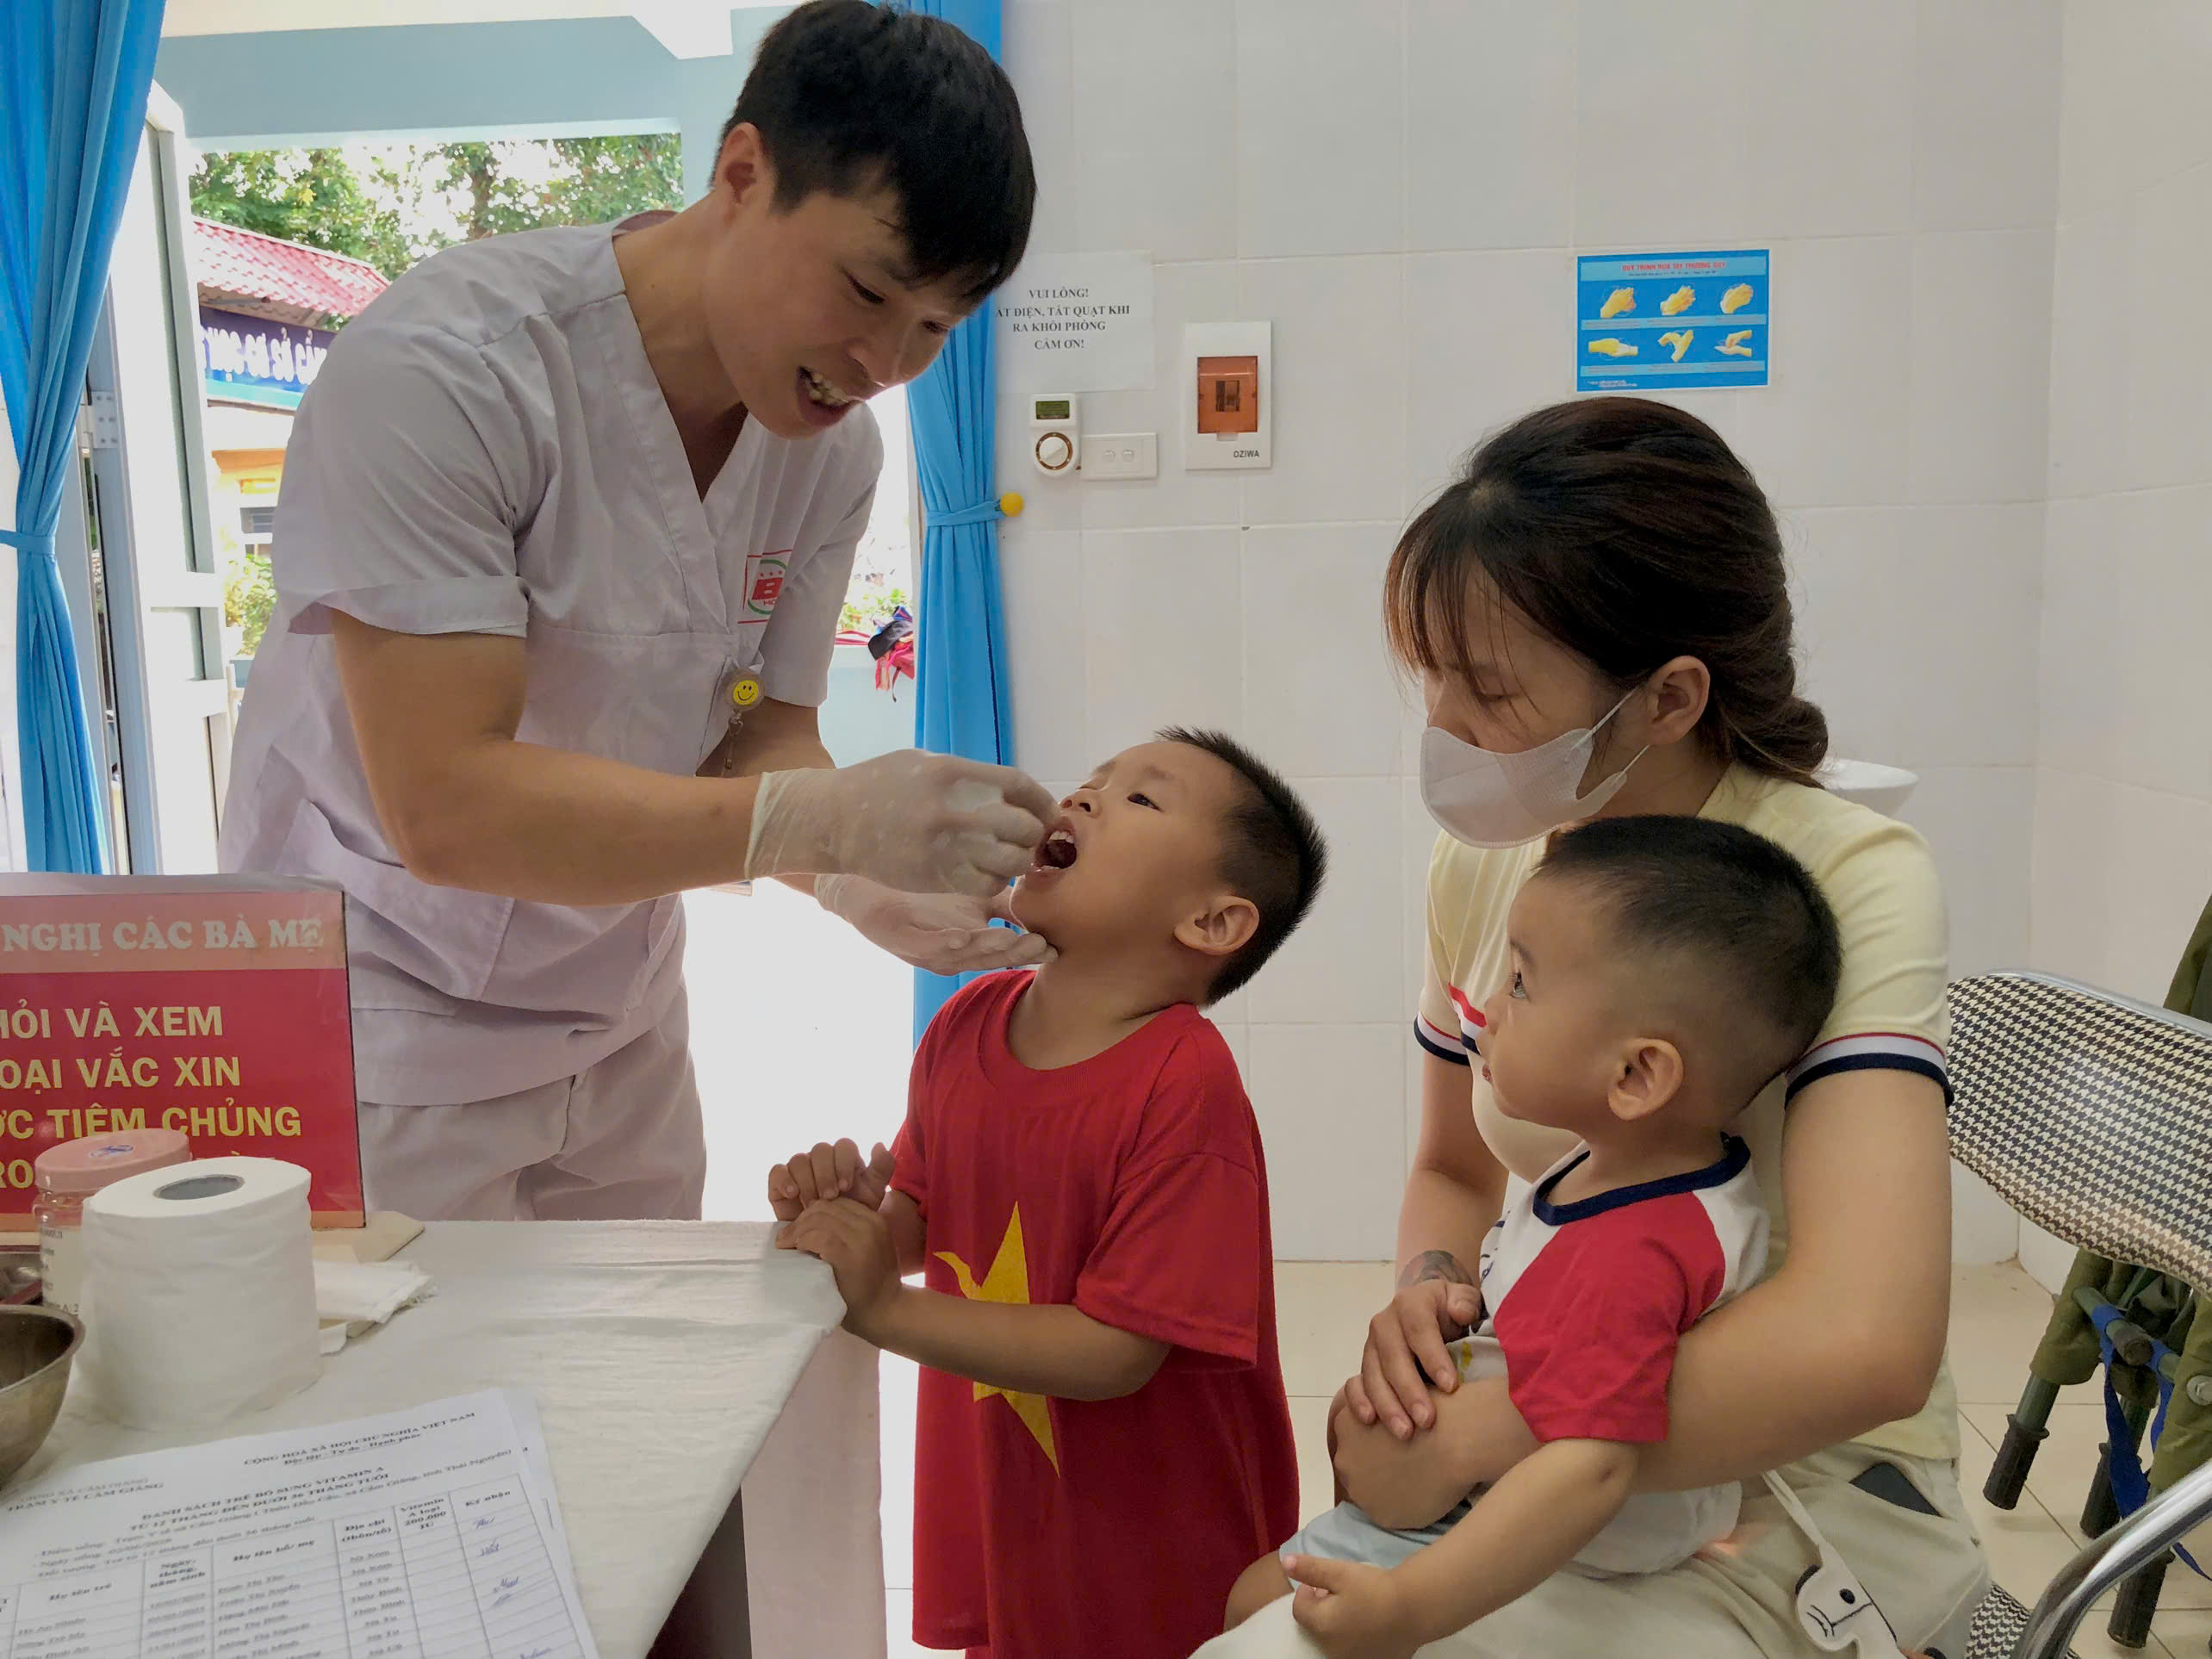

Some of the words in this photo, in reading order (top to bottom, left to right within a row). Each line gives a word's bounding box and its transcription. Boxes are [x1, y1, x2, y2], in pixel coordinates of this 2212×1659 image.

[1029, 289, 1049, 299] VUI
[1053, 286, 1089, 298] LÒNG!
[1073, 305, 1105, 317] QUẠT
[1109, 305, 1130, 314] KHI
[1013, 323, 1028, 332] RA
[1066, 319, 1106, 331] PHÒNG
[1064, 339, 1084, 349] ƠN!
[2, 923, 103, 957] NGHỊ
[113, 916, 192, 949] CÁC
[202, 913, 256, 948] BÀ
[268, 916, 324, 953] MẸ
[65, 1001, 121, 1038] VÀ
[134, 1005, 223, 1037] XEM
[76, 1046, 159, 1088] VẮC
[174, 1056, 240, 1087] XIN
[47, 1103, 146, 1139] TIÊM
[162, 1097, 301, 1137] CHỦNG
[450, 1412, 475, 1423] NAM
[315, 1469, 371, 1485] VITAMIN
